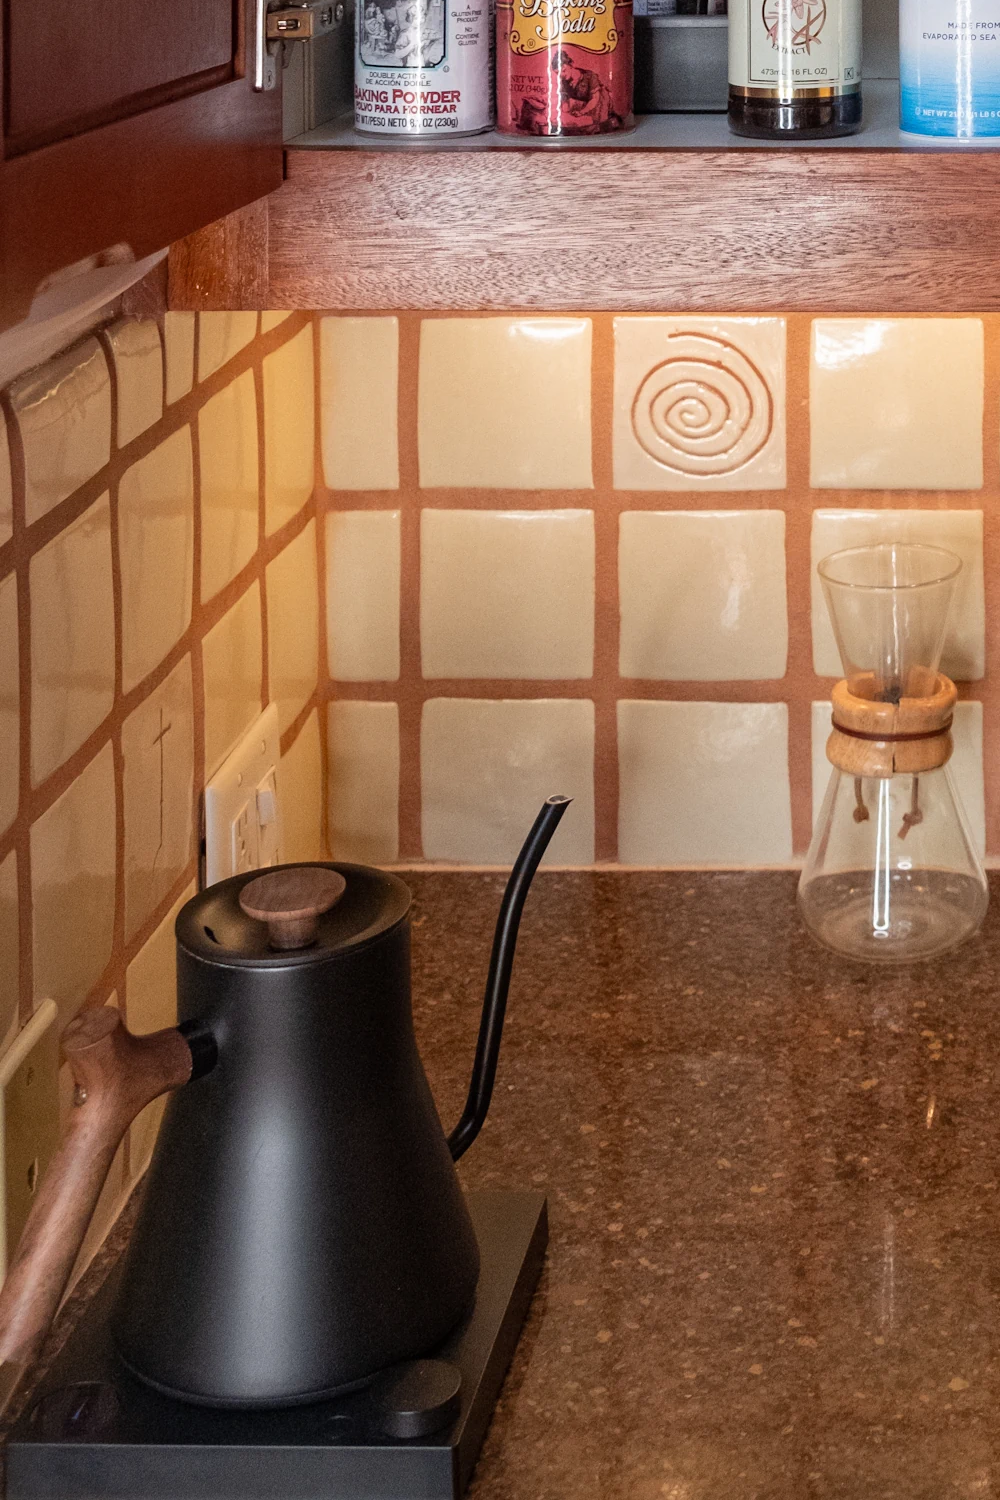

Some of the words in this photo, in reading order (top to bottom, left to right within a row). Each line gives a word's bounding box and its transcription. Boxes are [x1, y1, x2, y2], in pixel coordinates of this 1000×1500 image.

[535, 7, 596, 41] Soda
[814, 68, 828, 76] OZ)
[375, 78, 401, 87] ACCIÓN
[511, 75, 527, 83] NET
[529, 75, 544, 84] WT.
[355, 84, 389, 103] BAKING
[392, 89, 461, 105] POWDER
[356, 102, 373, 112] POLVO
[374, 104, 400, 114] PARA
[402, 104, 457, 114] HORNEAR
[923, 109, 935, 117] NET
[388, 117, 407, 127] NETO
[423, 118, 433, 127] OZ
[434, 117, 459, 129] (230g)
